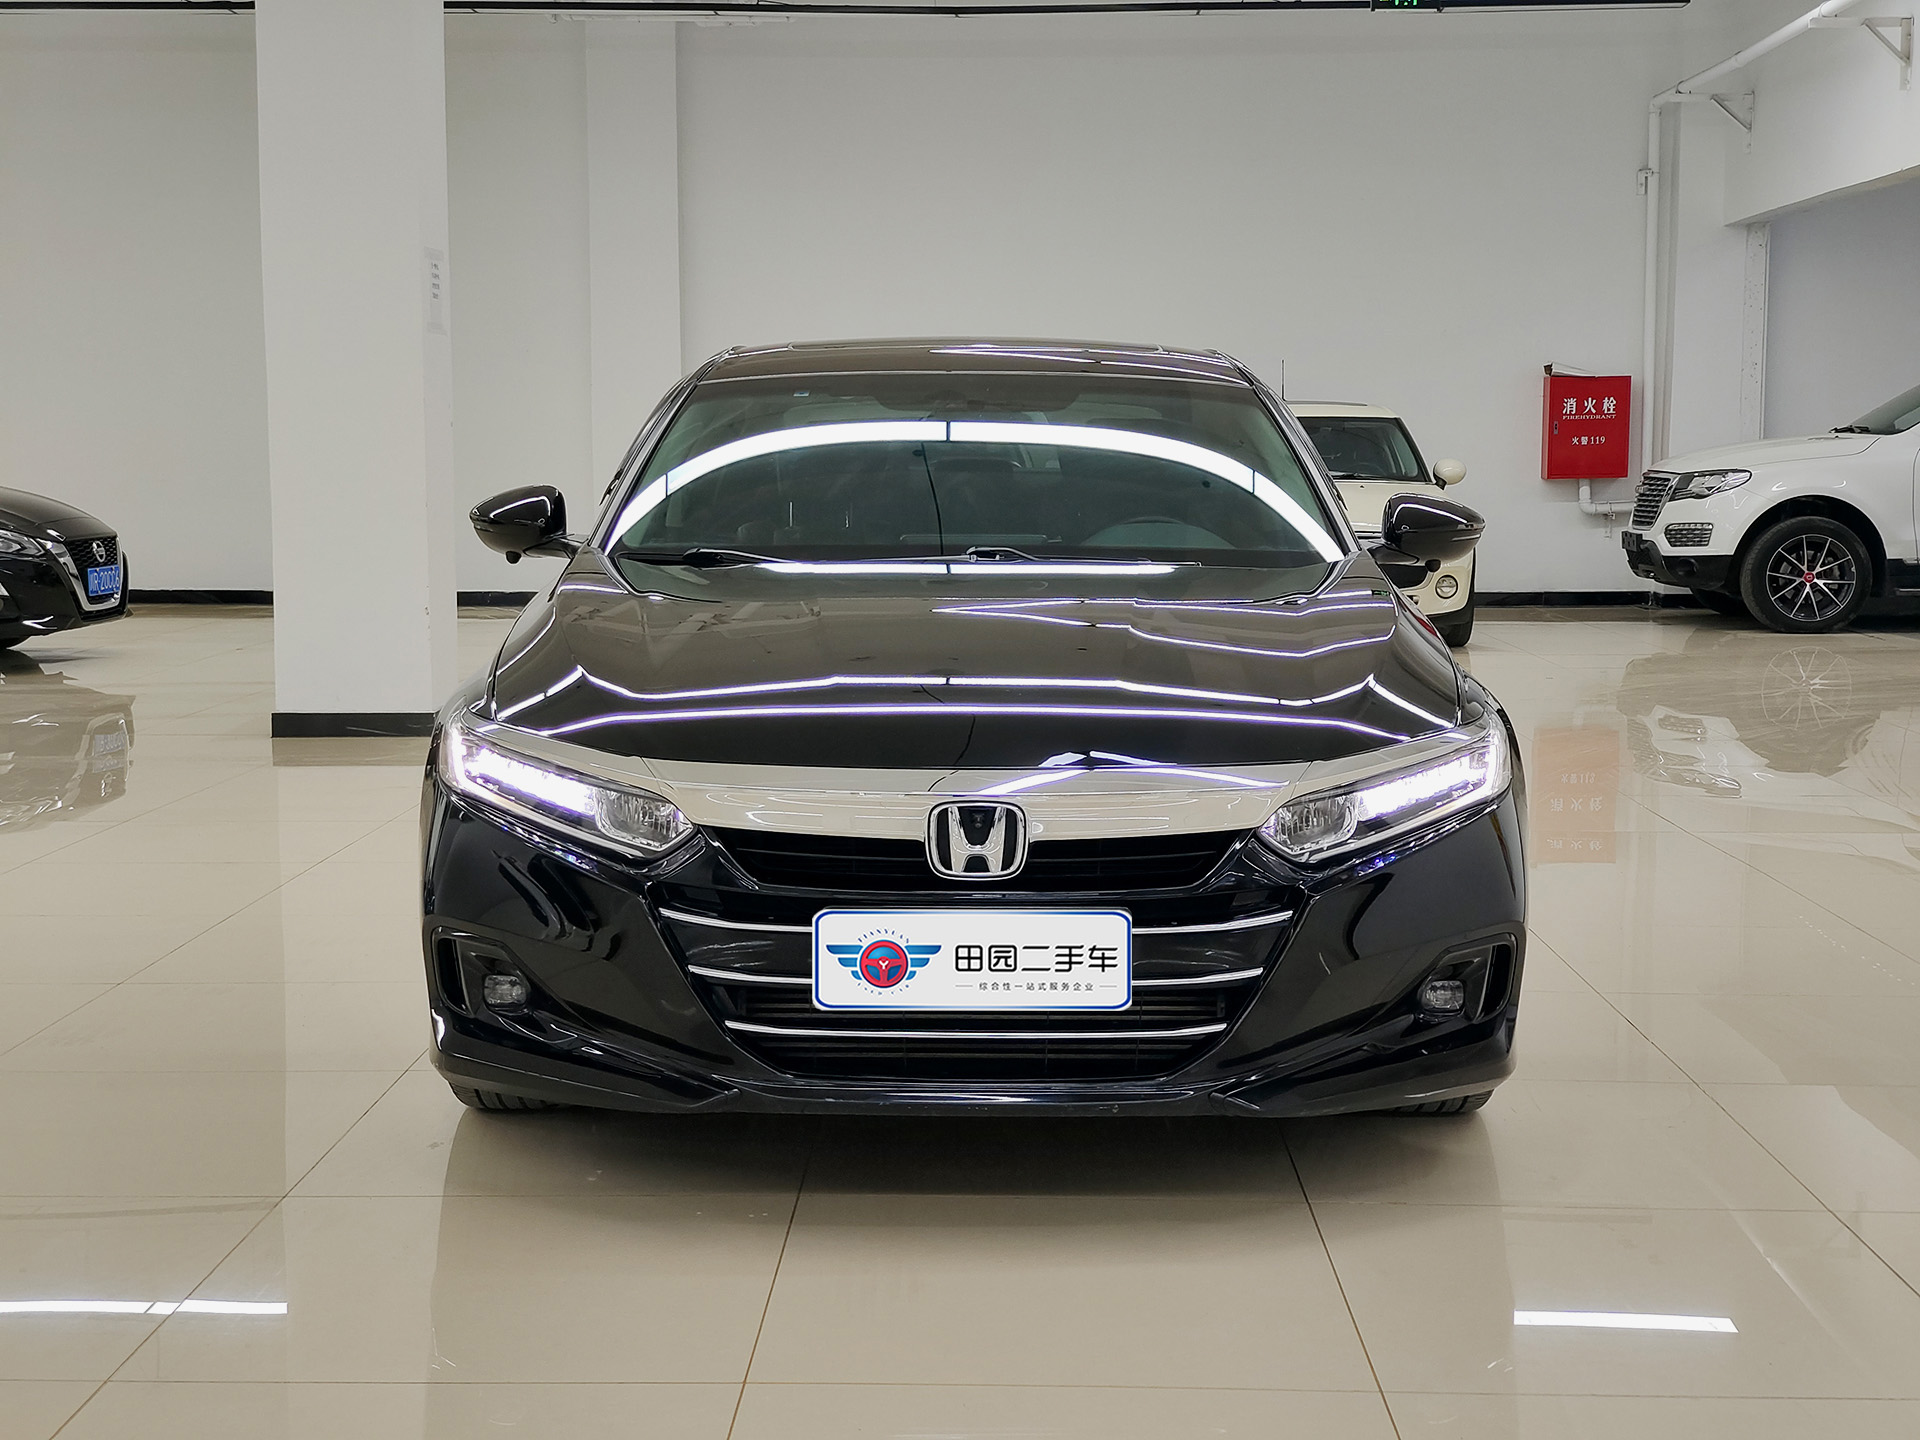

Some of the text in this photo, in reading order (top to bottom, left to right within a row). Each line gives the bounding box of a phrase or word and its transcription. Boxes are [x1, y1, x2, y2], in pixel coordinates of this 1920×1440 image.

[1562, 396, 1617, 414] 消火栓
[1571, 436, 1606, 446] 火警119
